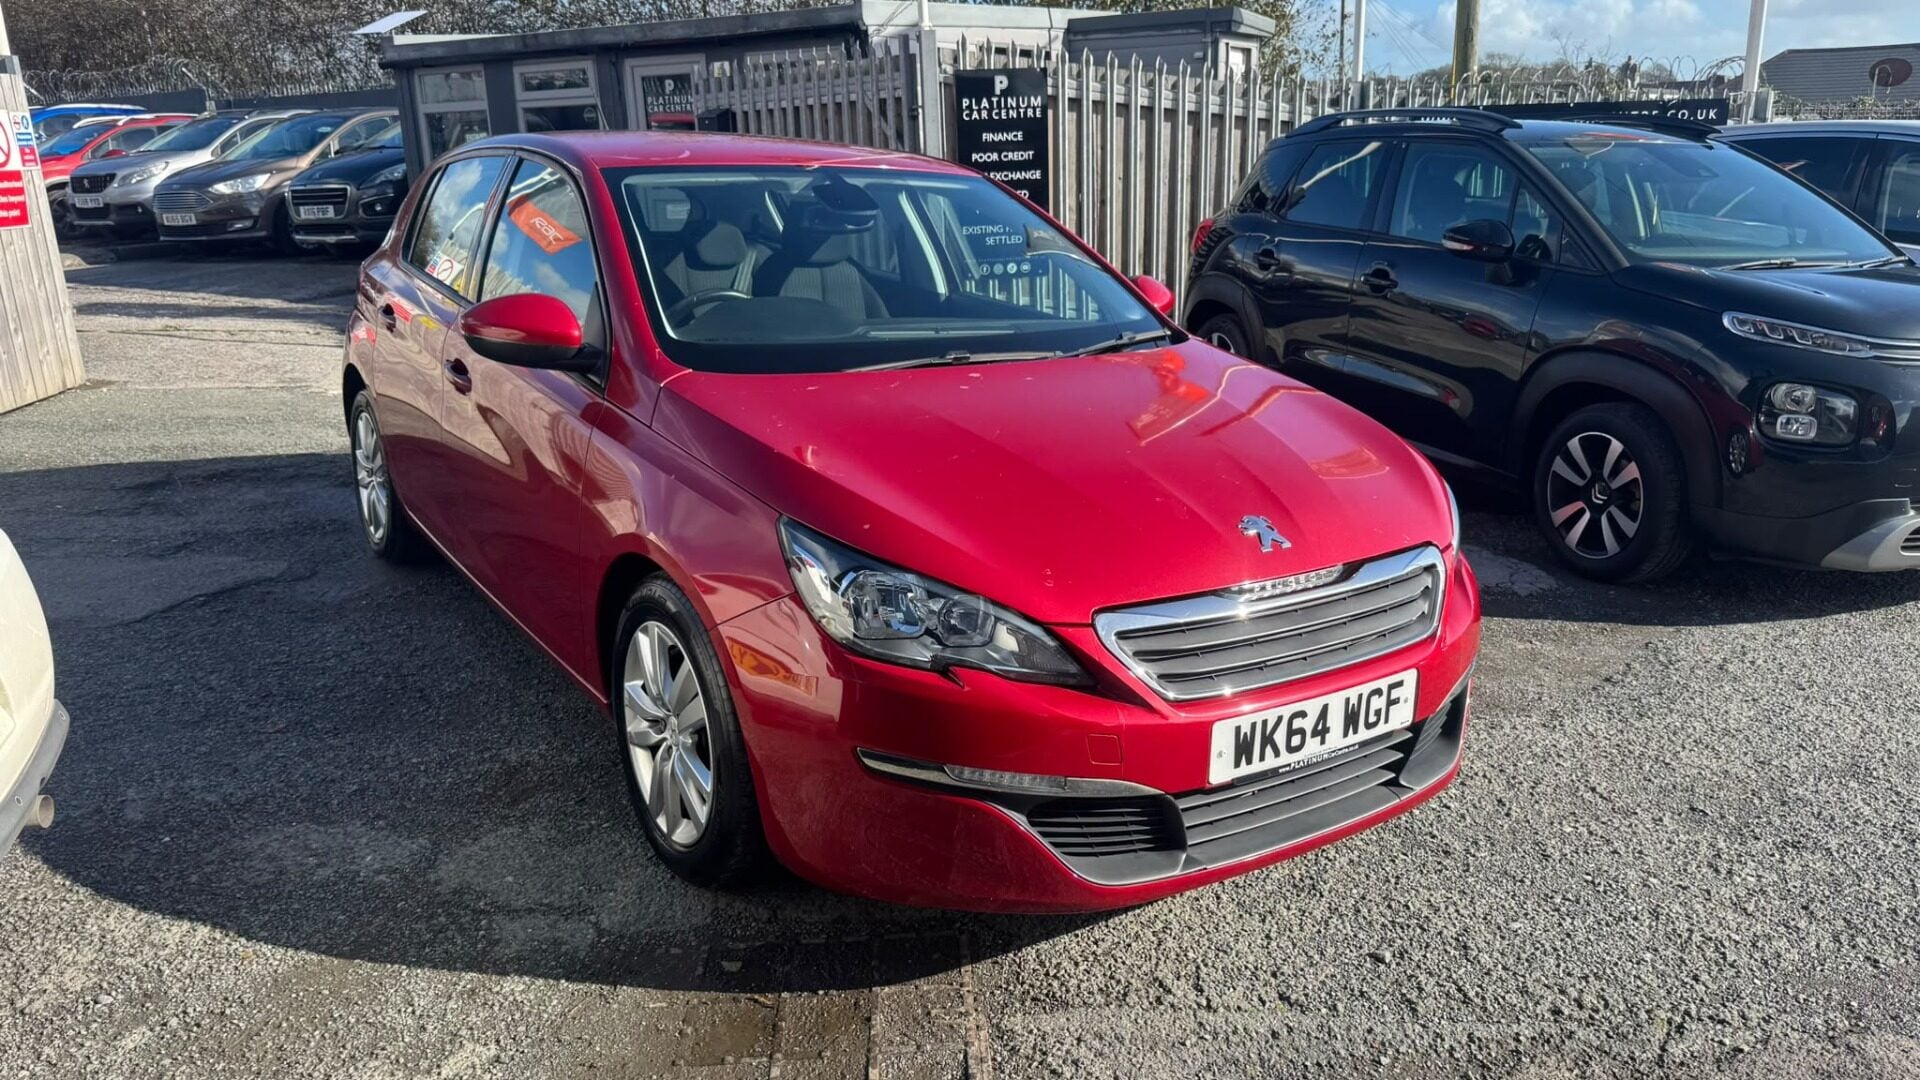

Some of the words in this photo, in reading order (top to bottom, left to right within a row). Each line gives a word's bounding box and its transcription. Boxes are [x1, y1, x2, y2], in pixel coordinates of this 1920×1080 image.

[993, 75, 1009, 95] P
[665, 103, 692, 113] CENTR
[962, 96, 1042, 110] PLATINUM
[962, 109, 989, 121] CAR
[992, 108, 1042, 120] CENTRE
[982, 131, 1023, 142] FINANCE
[971, 152, 999, 162] POOR
[1001, 150, 1035, 161] CREDIT
[962, 225, 1004, 235] EXISTING
[985, 235, 1023, 246] SETTLED
[1233, 702, 1331, 769] WK64
[1342, 679, 1404, 739] WGF
